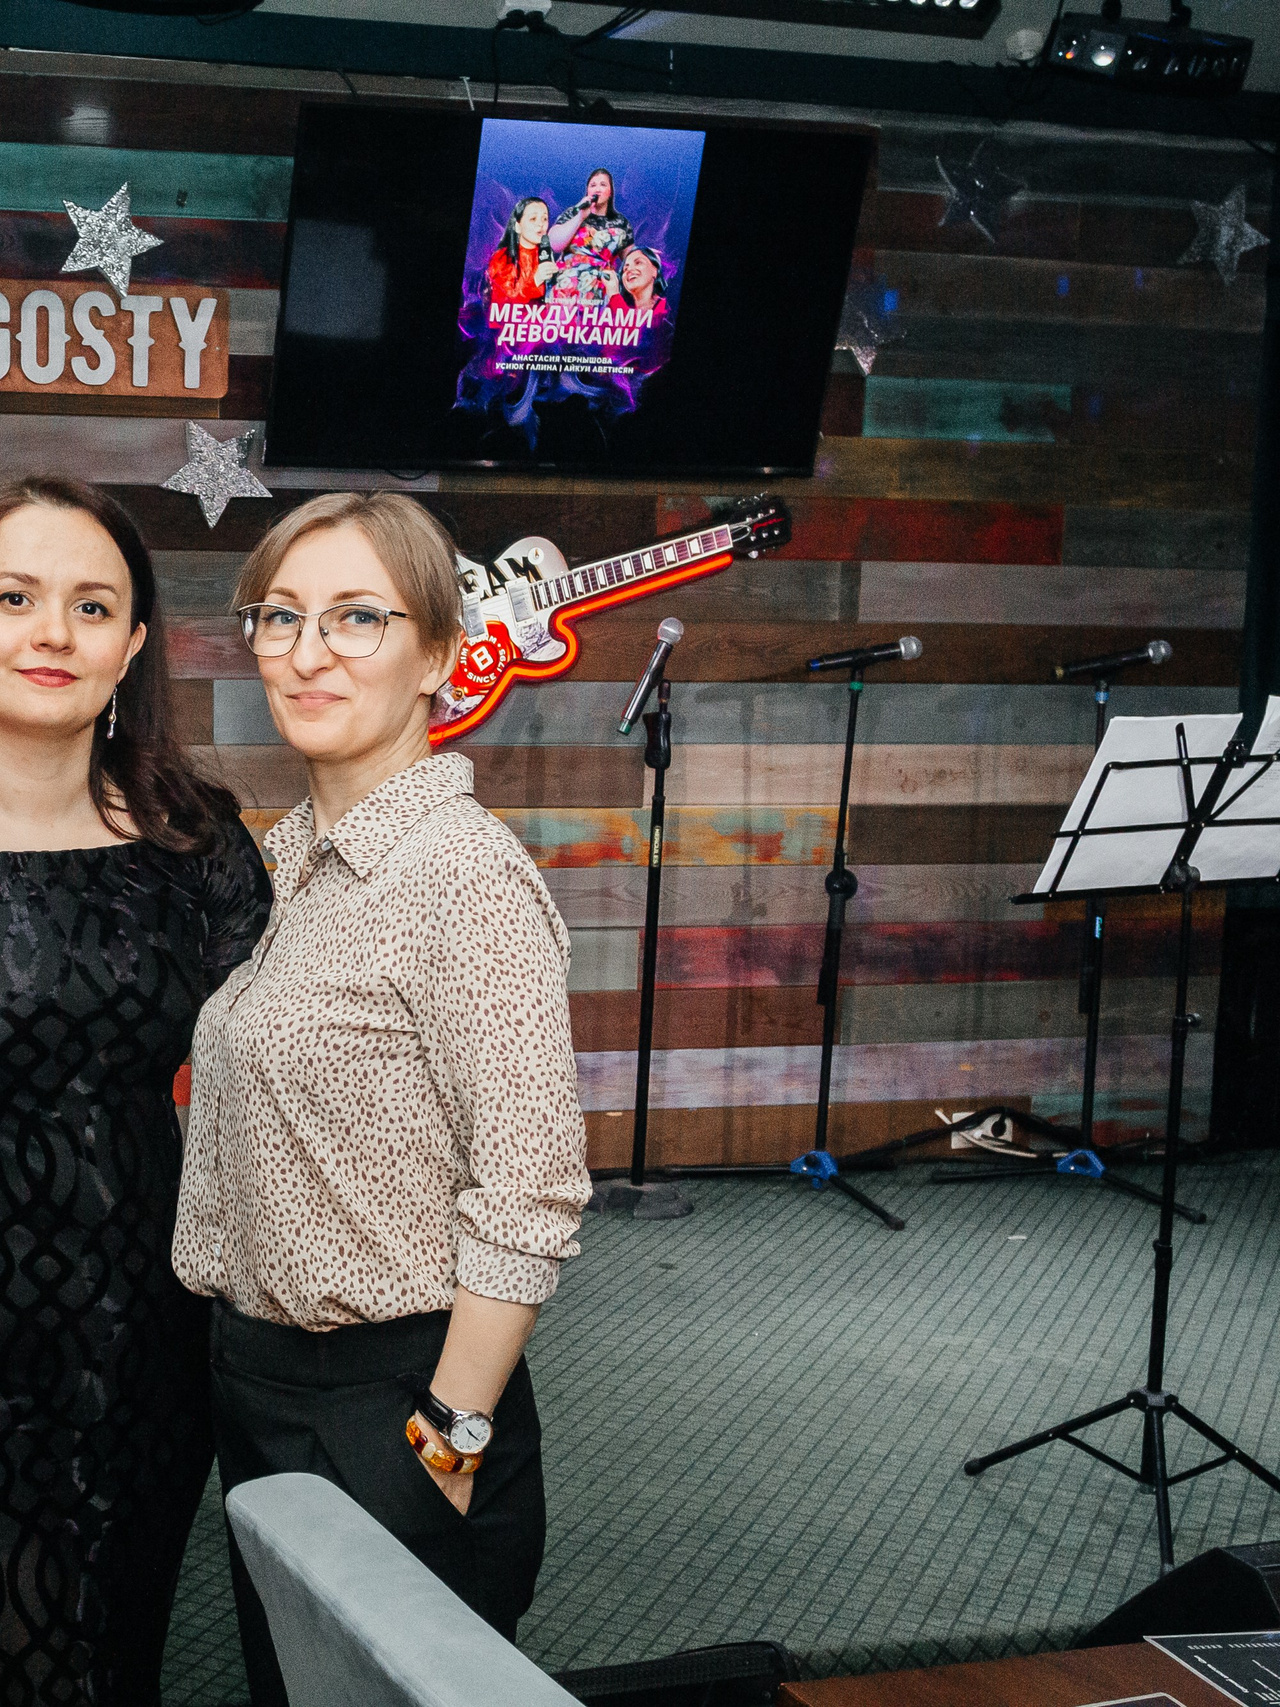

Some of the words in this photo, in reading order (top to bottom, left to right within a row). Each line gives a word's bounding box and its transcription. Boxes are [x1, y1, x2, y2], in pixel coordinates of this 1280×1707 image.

[489, 302, 578, 327] МЕЖДУ
[582, 307, 653, 328] НАМИ
[497, 323, 640, 346] ДЕВОЧКАМИ
[495, 362, 525, 371] УСИЮК
[525, 363, 558, 372] ГАЛИНА
[591, 365, 634, 375] АВЕТИСЯН
[512, 354, 560, 363] АНАСТАСИЯ
[561, 356, 613, 365] ЧЕРНЫШОВА
[460, 556, 542, 601] EAM
[460, 647, 468, 666] JIM
[471, 646, 494, 671] B
[466, 671, 497, 683] SINCE
